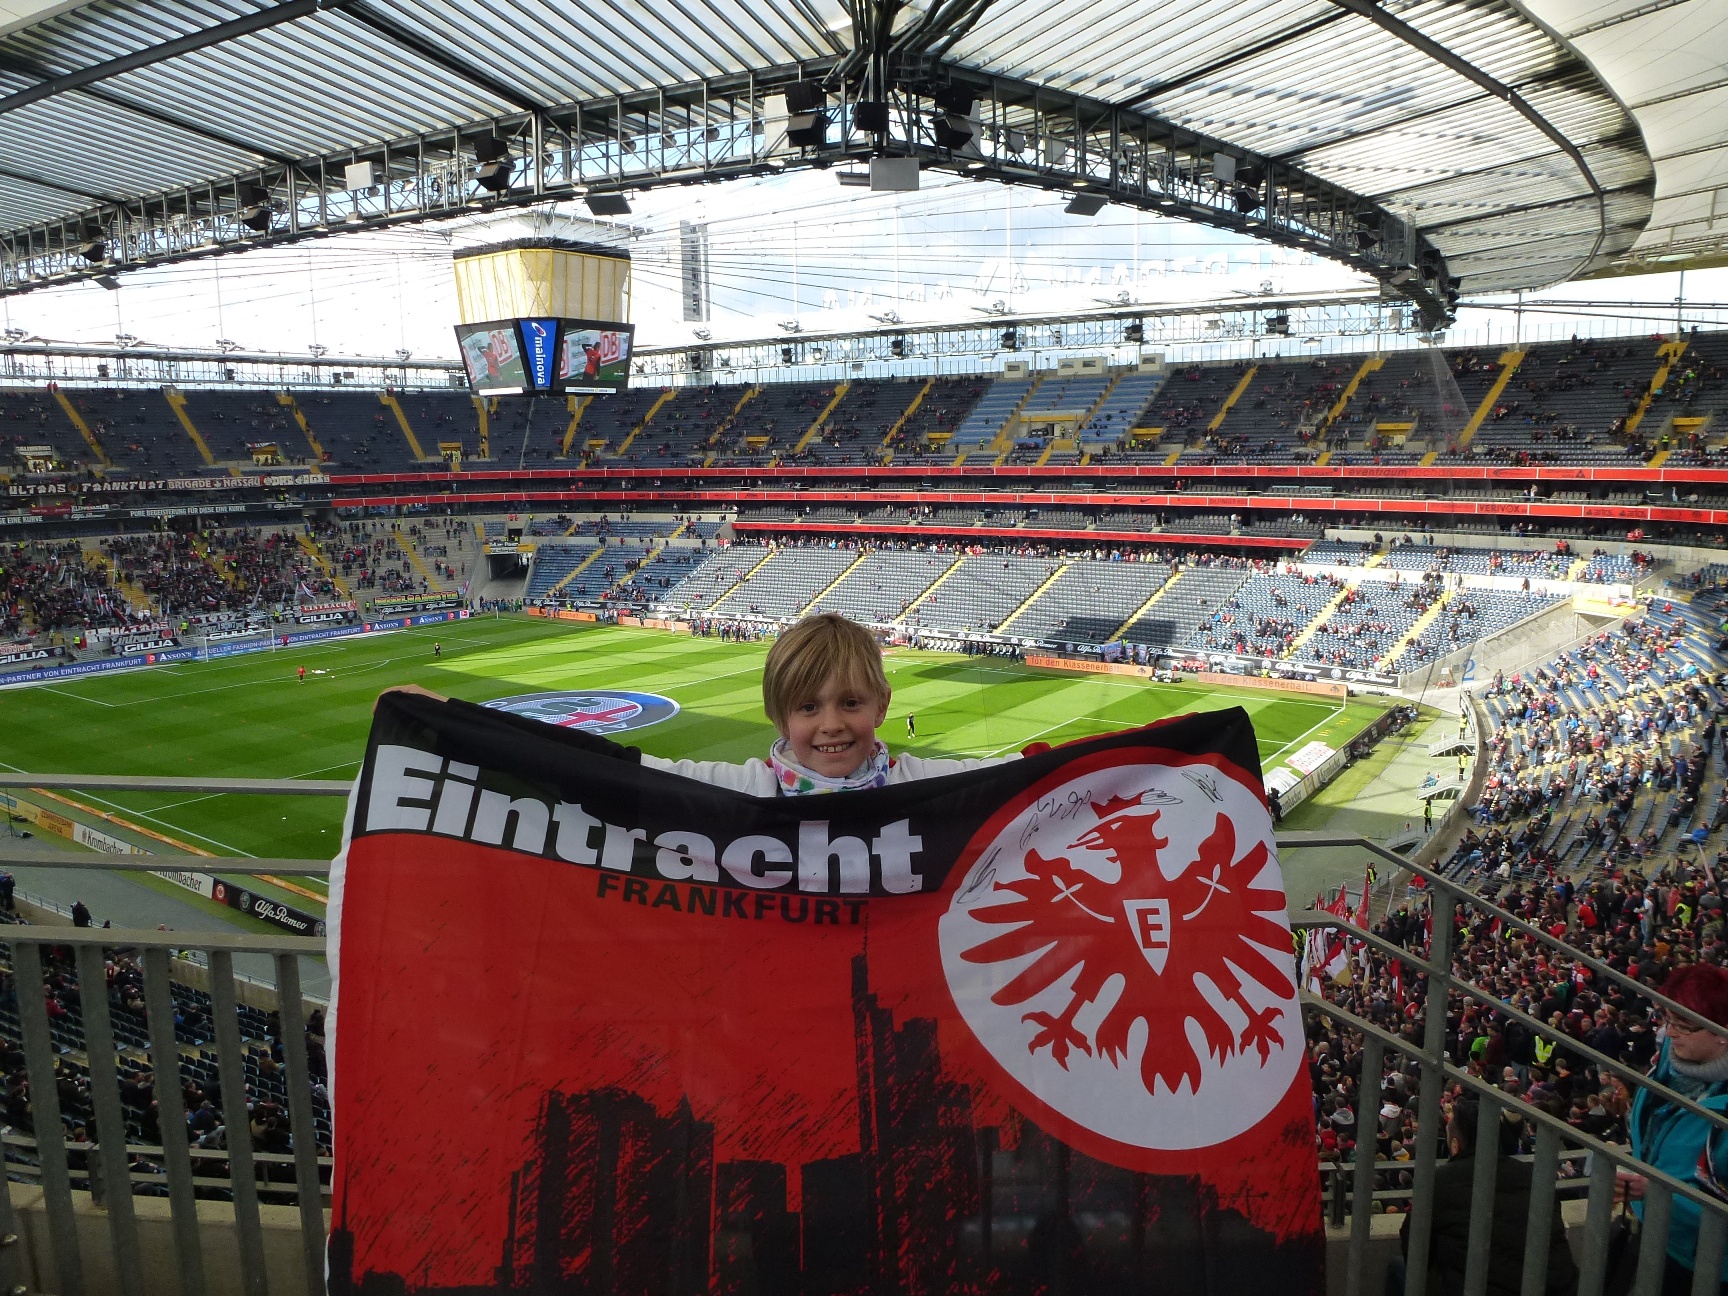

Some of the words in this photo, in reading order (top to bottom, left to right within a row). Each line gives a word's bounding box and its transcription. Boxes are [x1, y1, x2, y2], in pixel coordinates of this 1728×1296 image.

[534, 336, 546, 385] mainova
[9, 483, 66, 495] ULTRAS
[82, 480, 165, 493] FRANKFURT
[168, 479, 211, 489] BRIGADE
[223, 477, 260, 488] NASSAU
[300, 612, 344, 623] GIULIA
[299, 632, 329, 641] EINTRACHT
[330, 627, 360, 637] FRANKFURT
[125, 639, 174, 652] GIULIA
[0, 650, 48, 664] GIULIA
[160, 651, 192, 662] ANSON'S
[1031, 657, 1042, 665] für
[1046, 658, 1060, 667] den
[43, 670, 58, 678] VON
[61, 665, 100, 676] EINTRACHT
[102, 658, 142, 670] FRANKFURT
[1462, 659, 1475, 681] 2
[1205, 674, 1216, 683] für
[1222, 675, 1238, 684] den
[364, 744, 924, 894] Eintracht
[87, 830, 124, 854] Krombacher
[597, 871, 869, 925] FRANKFURT
[255, 899, 276, 919] Alfa
[276, 906, 308, 930] Romeo
[1136, 907, 1169, 950] E
